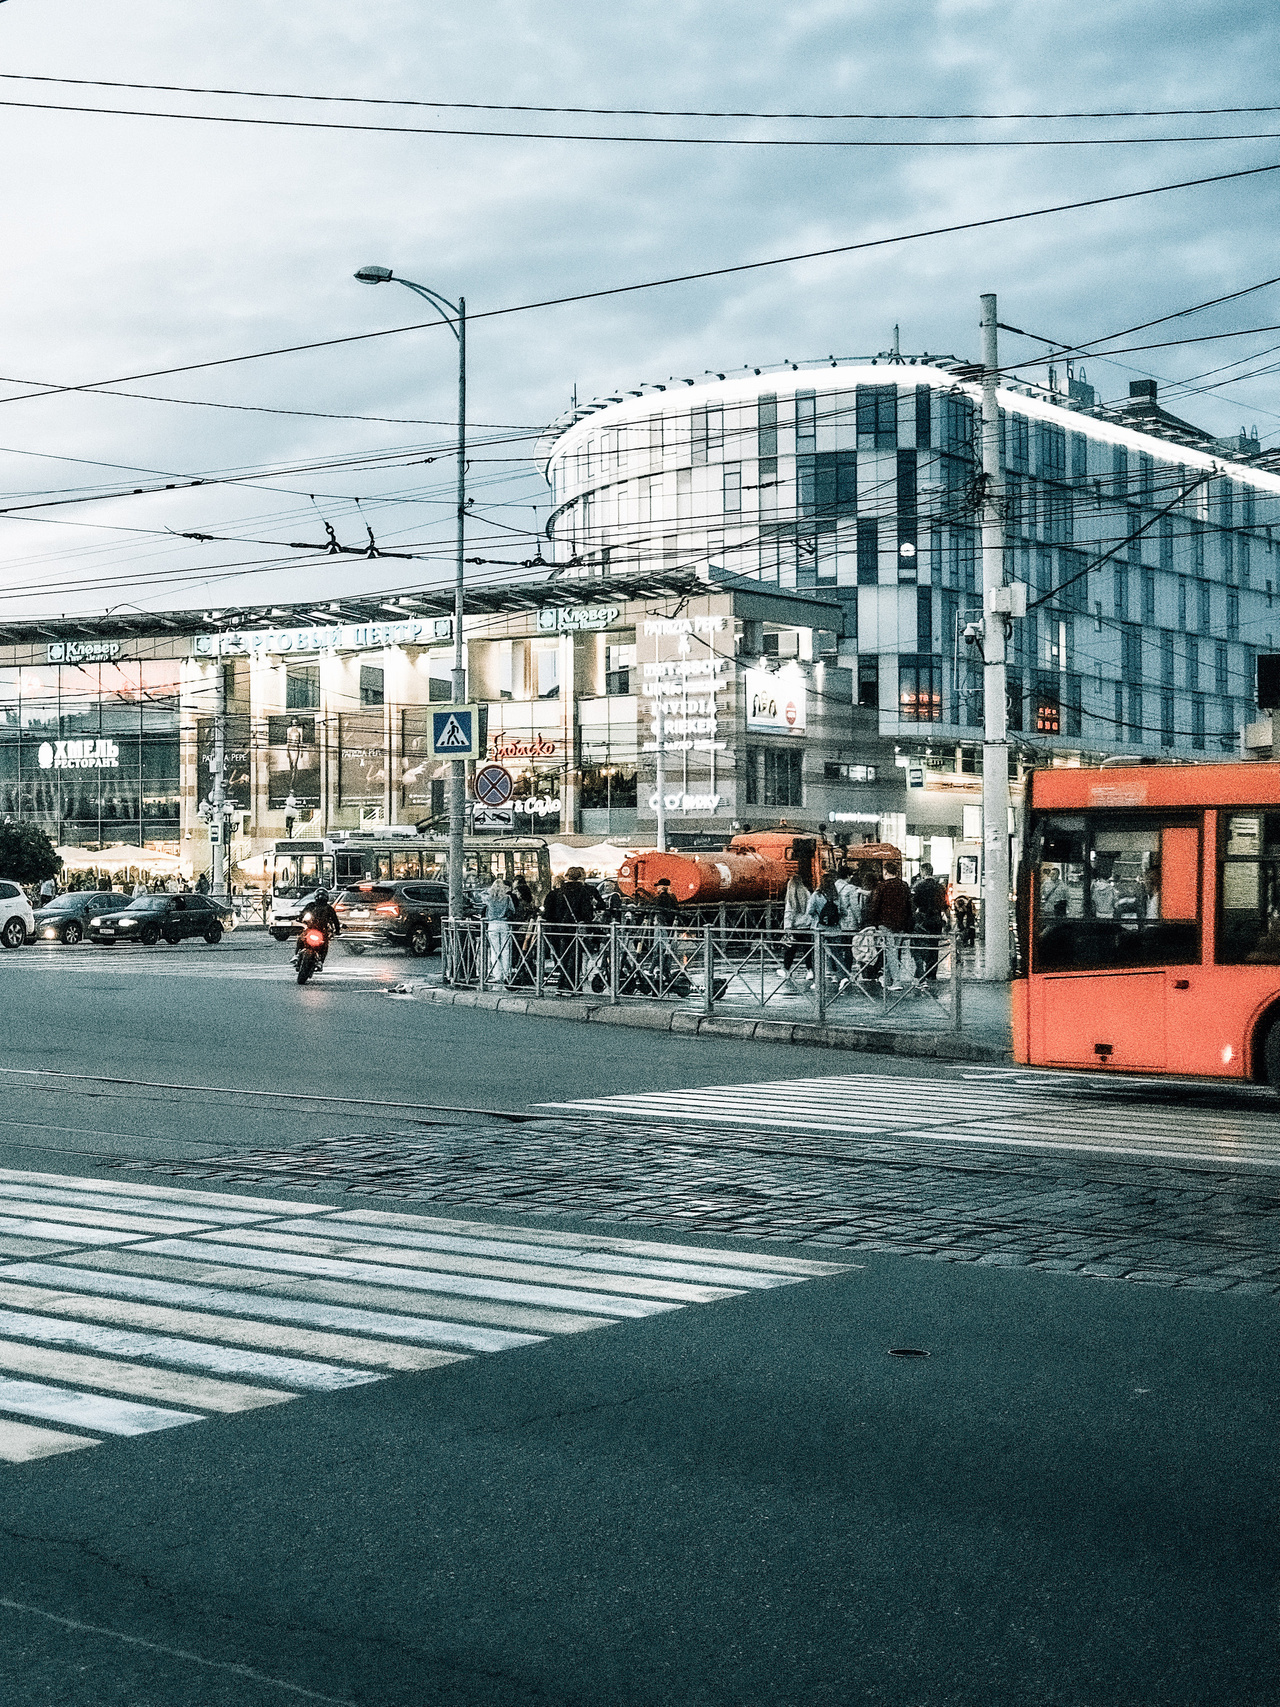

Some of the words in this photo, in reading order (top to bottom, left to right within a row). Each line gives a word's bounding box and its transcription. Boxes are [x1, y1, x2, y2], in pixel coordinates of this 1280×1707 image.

[558, 607, 619, 624] Кловер
[353, 621, 424, 647] ЦЕНТР
[65, 641, 120, 656] Кловер
[664, 718, 718, 735] RIEKER
[54, 740, 119, 759] ХМЕЛЬ
[231, 753, 247, 762] PEPE
[54, 758, 119, 769] РЕСТОРАНЪ
[524, 795, 562, 817] Сало
